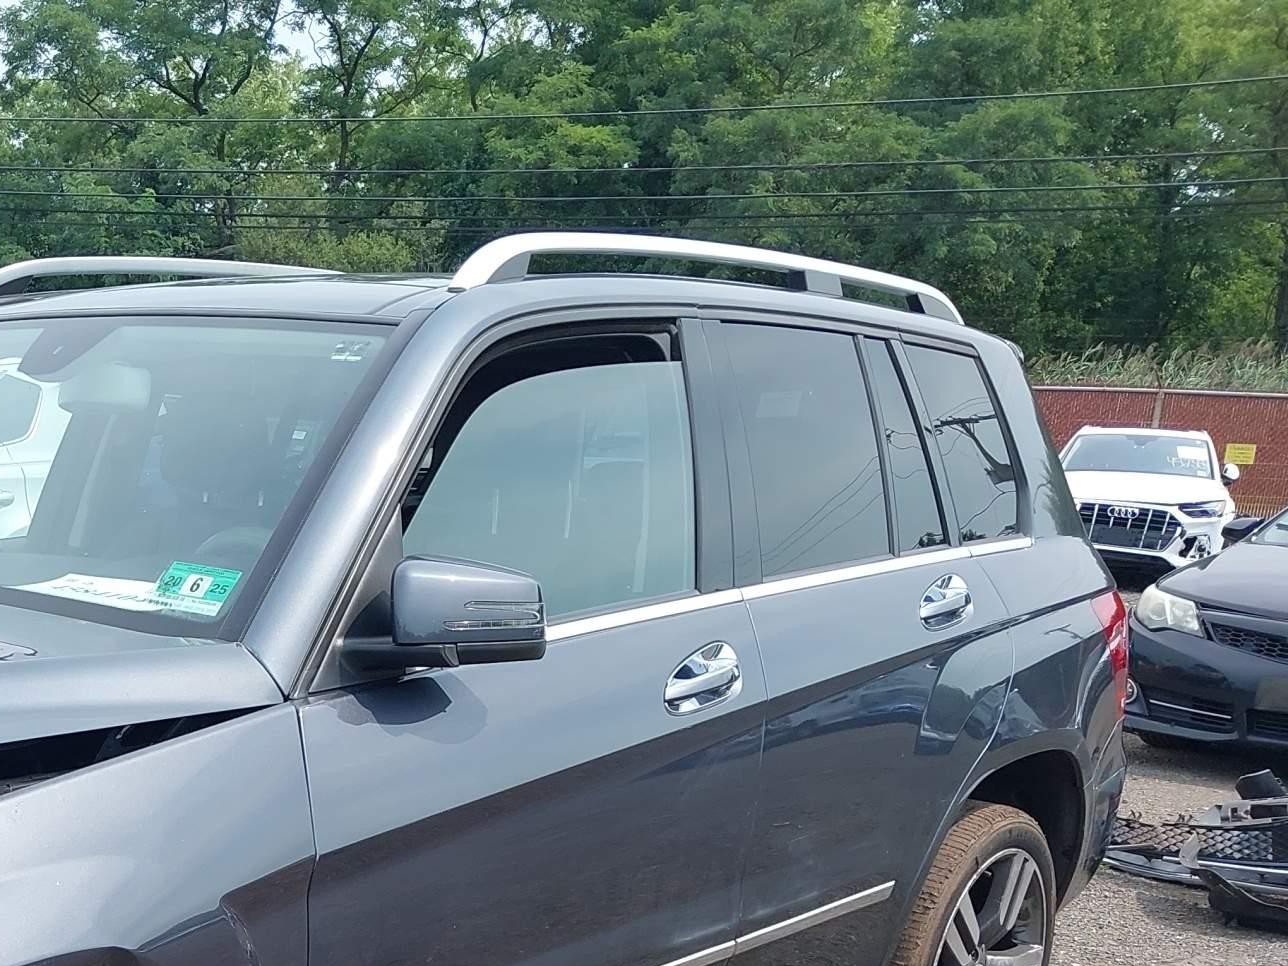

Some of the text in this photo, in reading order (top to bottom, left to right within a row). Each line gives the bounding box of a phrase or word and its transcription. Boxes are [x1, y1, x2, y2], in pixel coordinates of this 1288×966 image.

[164, 575, 229, 595] 20 6 25
